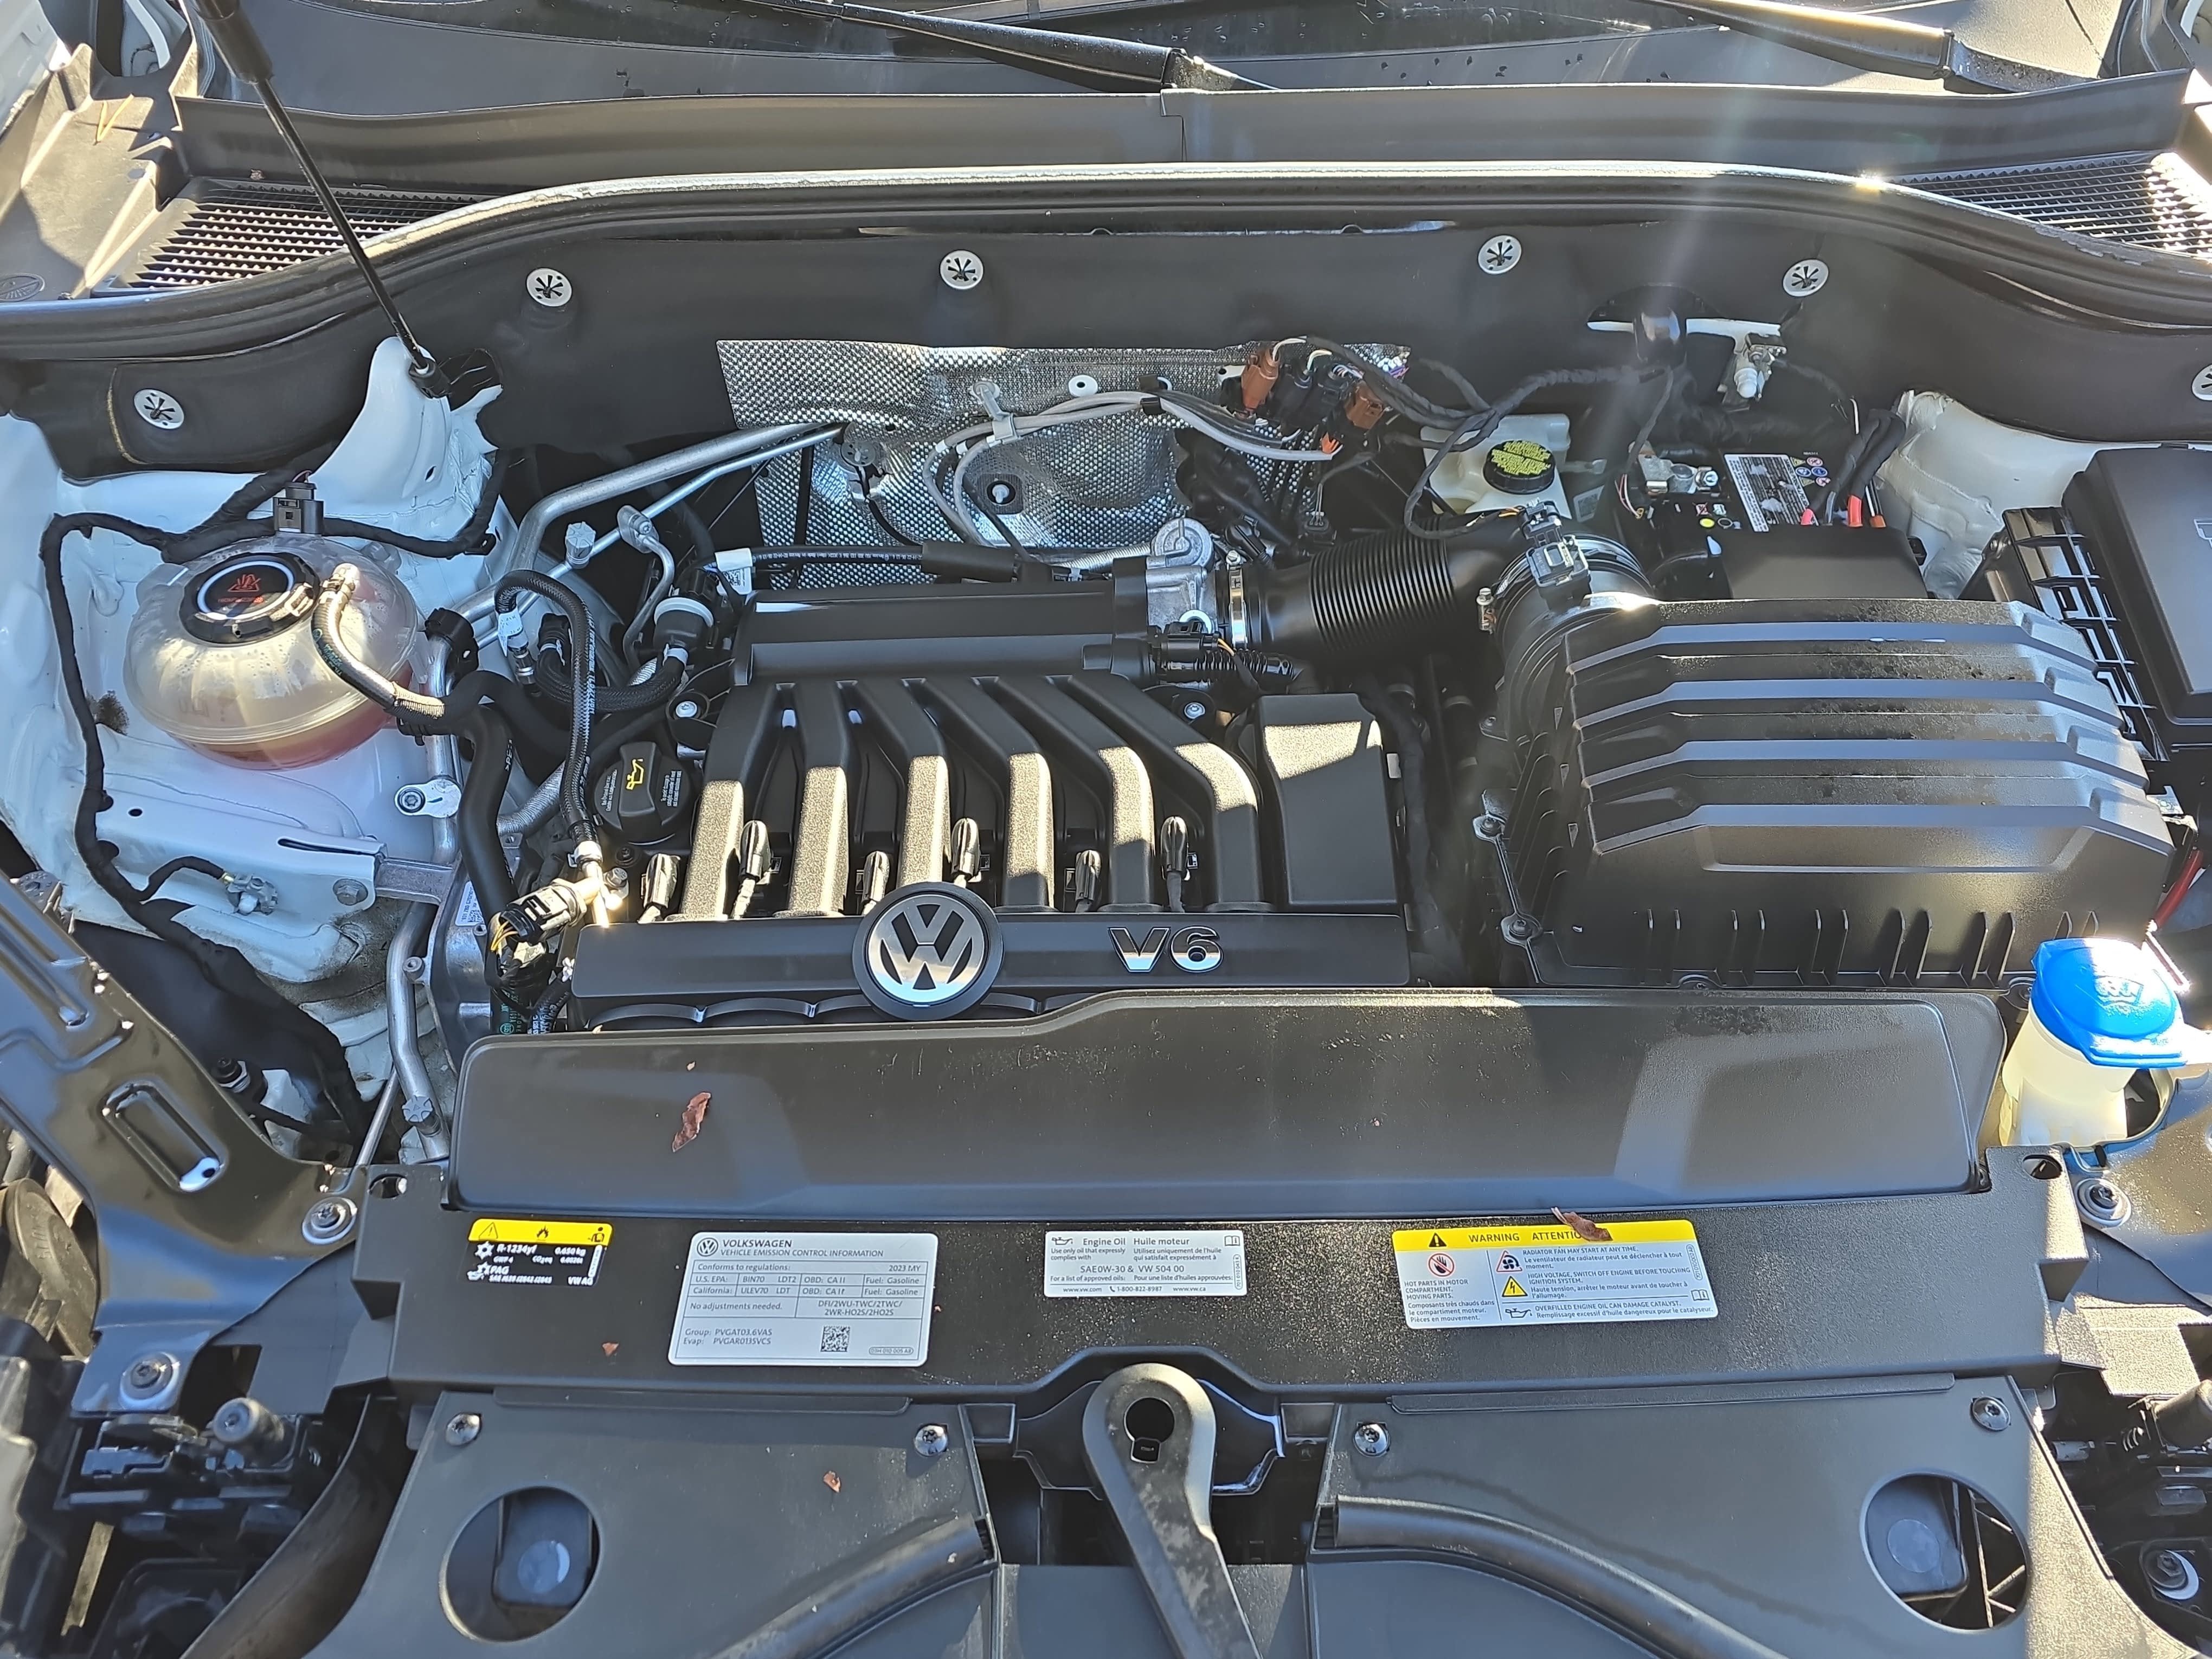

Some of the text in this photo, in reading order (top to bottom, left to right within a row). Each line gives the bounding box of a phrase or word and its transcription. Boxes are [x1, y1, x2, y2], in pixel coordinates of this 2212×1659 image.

[1109, 926, 1224, 973] V6
[1468, 1231, 1583, 1243] WARNING ATTENTIO
[723, 1239, 792, 1248] VOLKSWAGEN
[1083, 1237, 1126, 1248] Engine Oil
[489, 1265, 509, 1275] PAG
[745, 1263, 790, 1272] regulations:
[1080, 1265, 1126, 1273] SAE0W-30
[568, 1276, 593, 1285] VW AG
[1405, 1285, 1454, 1294] COMPARTMENT.
[702, 1302, 750, 1311] adjustments
[751, 1302, 782, 1310] needed.
[1536, 1311, 1575, 1319] Remplissage
[685, 1328, 711, 1336] Group:
[683, 1337, 704, 1346] Evap:
